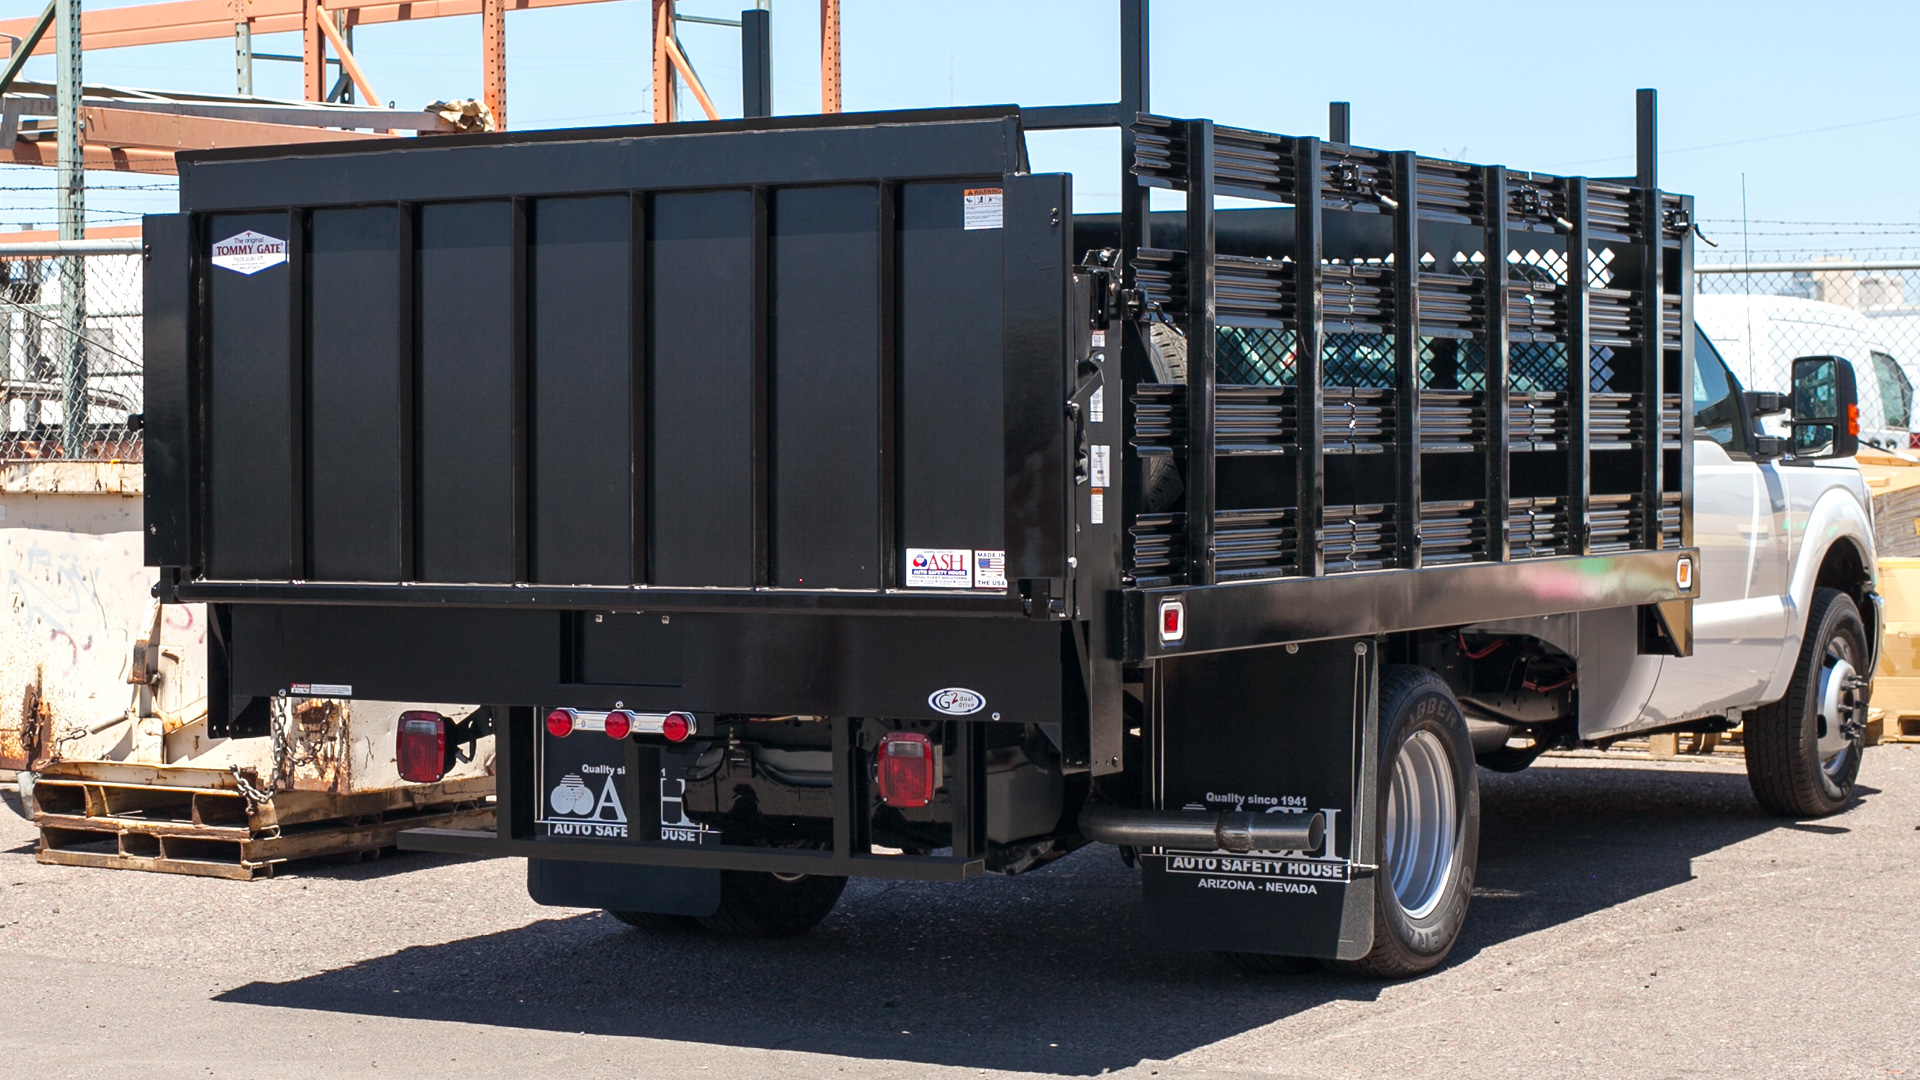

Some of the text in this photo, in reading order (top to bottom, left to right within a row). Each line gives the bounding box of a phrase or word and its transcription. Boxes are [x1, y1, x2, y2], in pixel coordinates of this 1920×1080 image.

[216, 244, 281, 256] TOMMY GATE
[927, 553, 964, 571] ASH
[581, 764, 615, 777] Quality
[1206, 792, 1307, 806] Quality since 1941
[553, 823, 696, 842] AUTO SAFE OUSE
[1172, 856, 1343, 878] AUTO SAFETY HOUSE
[1198, 878, 1256, 891] ARIZONA
[1265, 882, 1318, 895] NEVADA
